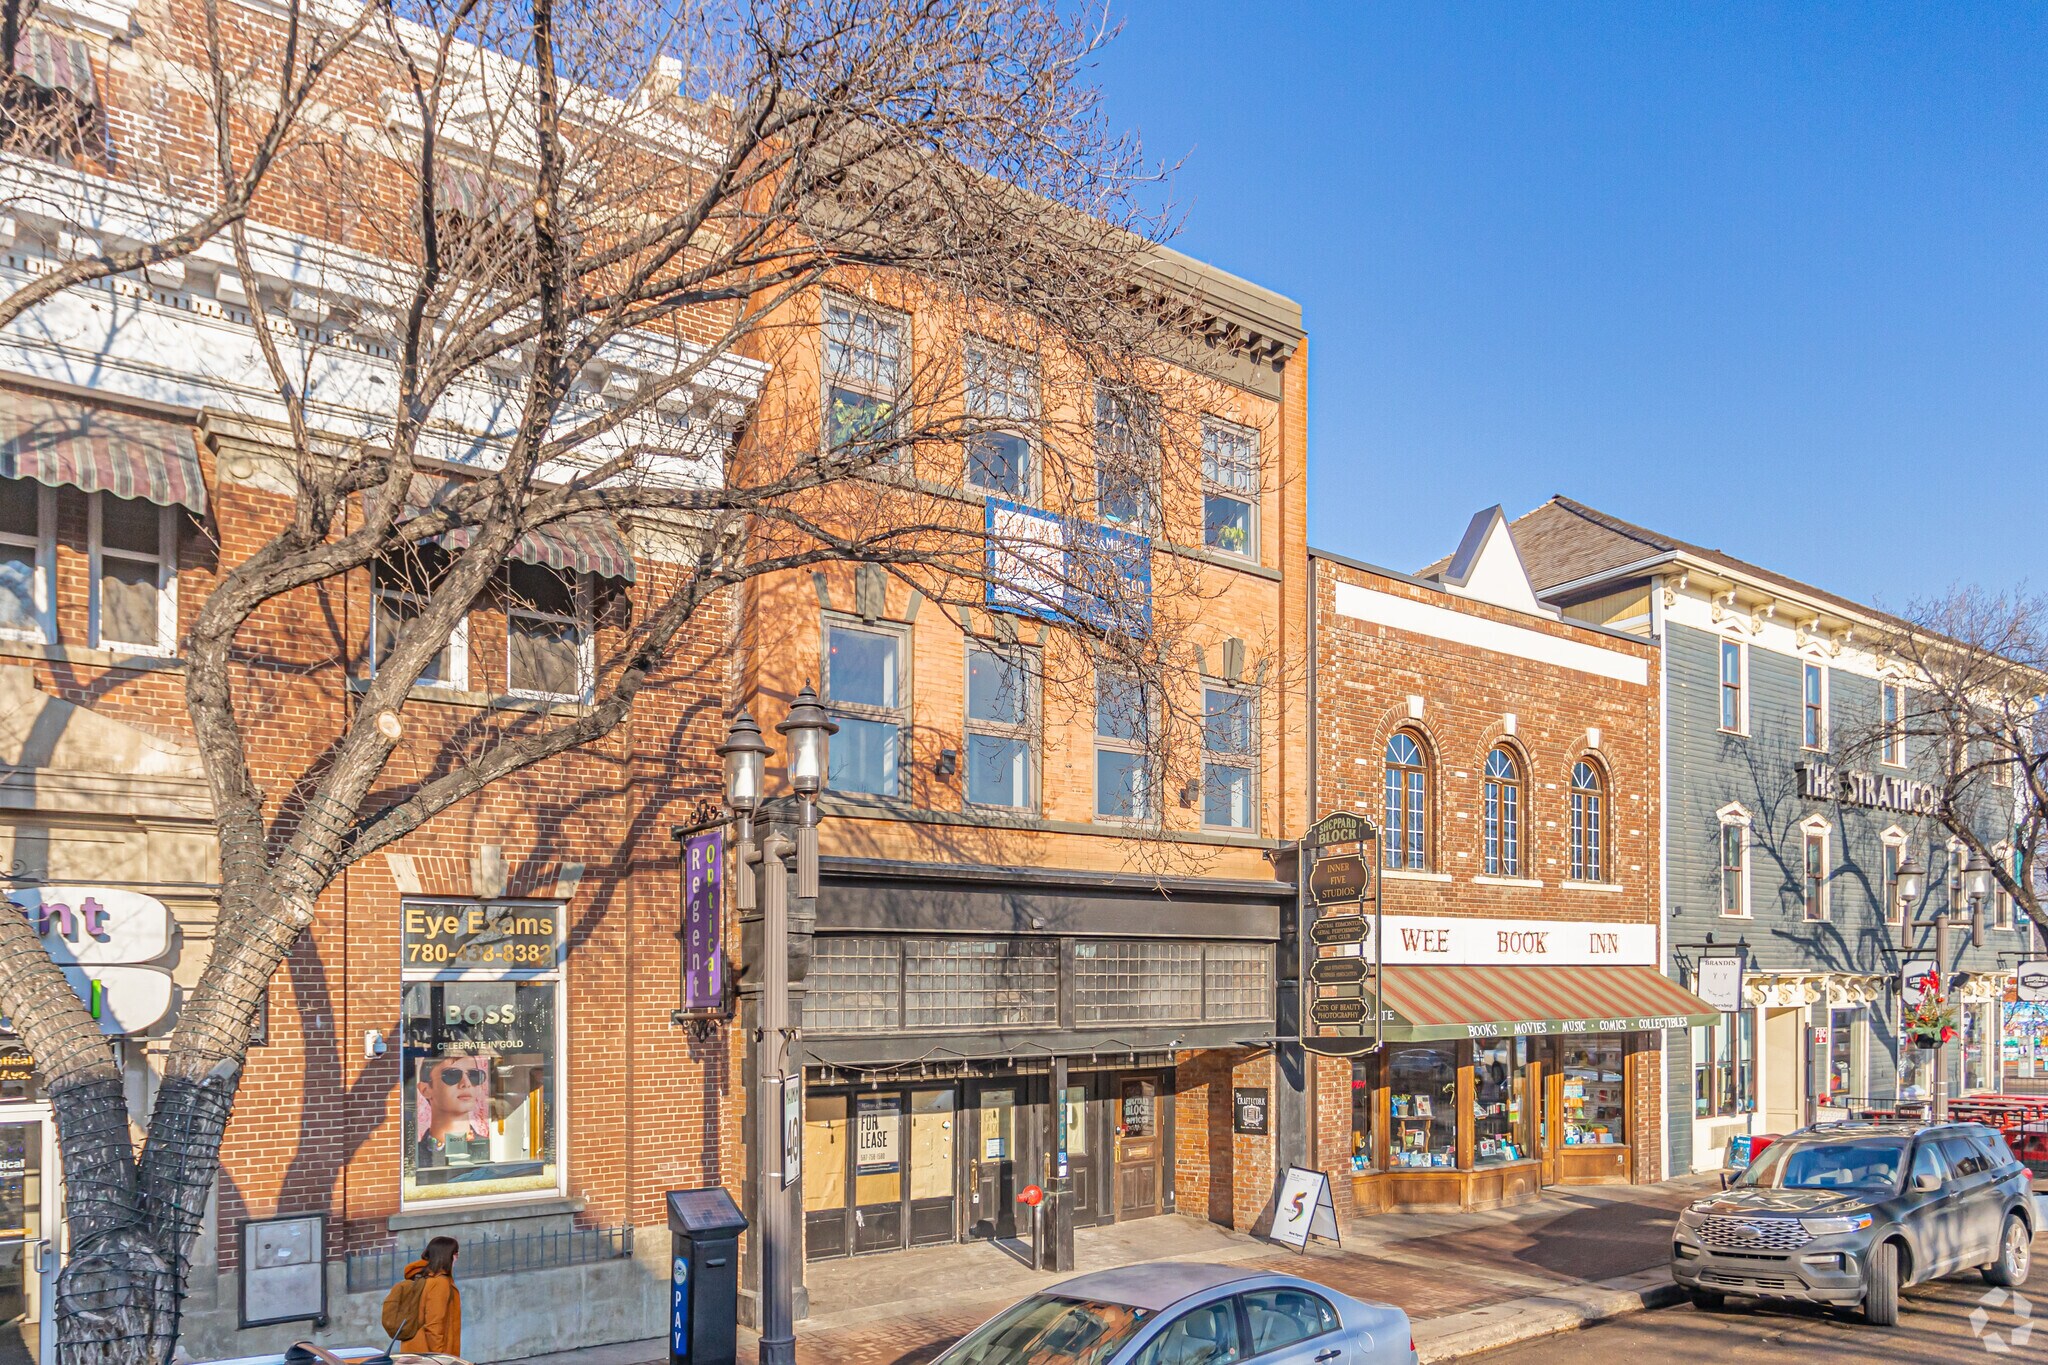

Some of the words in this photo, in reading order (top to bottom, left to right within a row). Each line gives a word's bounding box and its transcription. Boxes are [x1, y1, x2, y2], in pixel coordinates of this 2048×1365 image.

[1803, 762, 1837, 799] THE
[1848, 769, 1948, 814] STRATHCON
[1319, 818, 1357, 834] SHEPPARD
[1319, 829, 1357, 844] BLOCK
[1327, 863, 1350, 873] INNER
[1330, 875, 1346, 885] FIVE
[1322, 887, 1355, 899] STUDIOS
[406, 910, 460, 940] Eye
[468, 911, 553, 935] Exams
[692, 848, 700, 997] Regent
[706, 844, 716, 996] Optical
[1400, 927, 1450, 954] WEE
[1497, 930, 1550, 954] BOOK
[1590, 932, 1619, 953] INN
[407, 943, 552, 962] 780-438-8382
[445, 1004, 516, 1025] BOSS
[1317, 1011, 1359, 1019] PHOTOGRAPHY
[1467, 1023, 1497, 1037] BOOKS
[1514, 1022, 1547, 1034] MOVIES
[1561, 1021, 1586, 1033] MUSIC
[1600, 1019, 1626, 1031] COMICS
[1638, 1016, 1688, 1029] COLLECTIBLES
[437, 1040, 486, 1050] CELEBRATE
[488, 1040, 498, 1049] IN
[499, 1039, 524, 1049] GOLD
[1126, 1105, 1149, 1116] BLOCK
[861, 1114, 879, 1131] FOR
[786, 1116, 798, 1164] 40
[860, 1131, 888, 1149] LEASE
[674, 1290, 682, 1349] PAY
